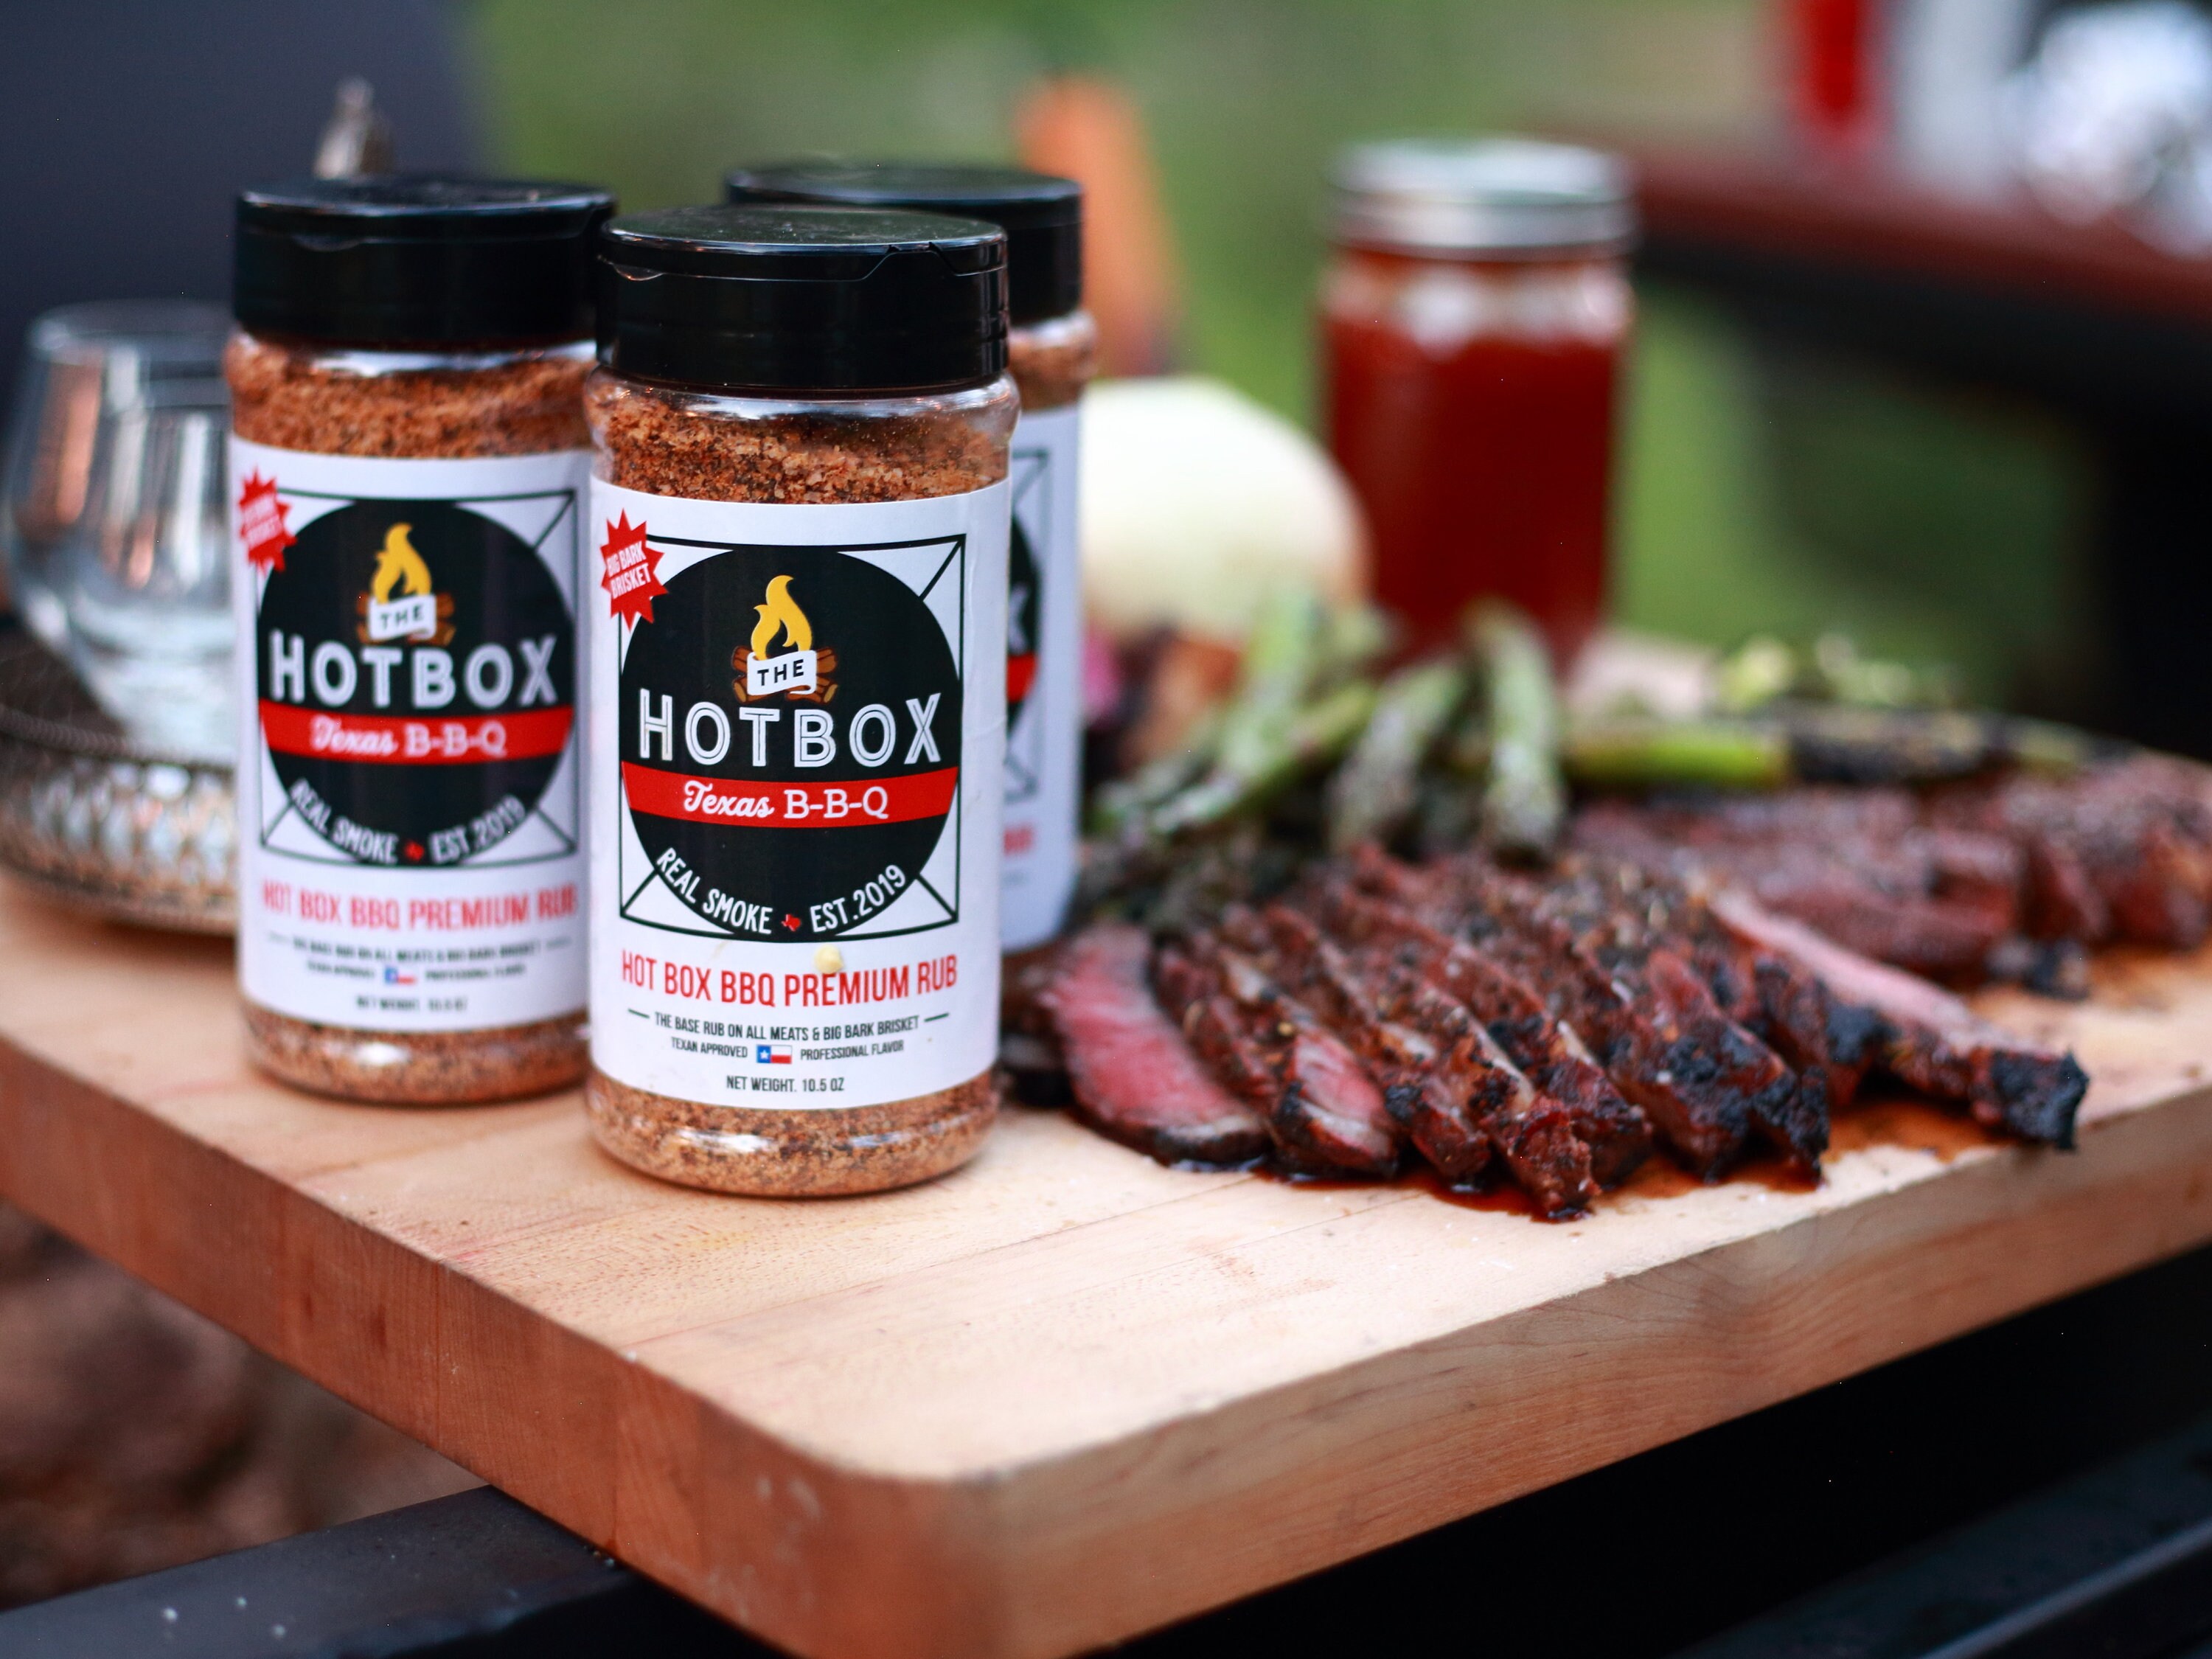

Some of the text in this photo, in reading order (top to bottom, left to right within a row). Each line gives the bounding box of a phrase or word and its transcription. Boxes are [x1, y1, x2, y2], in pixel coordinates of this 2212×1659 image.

[619, 540, 647, 571] BARK
[610, 563, 651, 599] BRISKET
[380, 605, 425, 630] THE
[268, 629, 557, 709] HOTBOX
[757, 659, 804, 686] THE
[310, 714, 507, 758] Texas B-B-Q
[639, 688, 941, 768] HOTBOX
[684, 780, 888, 819] Texas B-B-Q
[290, 777, 332, 835] REAL
[333, 815, 399, 863] SMOKE
[261, 878, 292, 914] HOT
[299, 887, 341, 922] BOX
[350, 894, 400, 931] BBQ
[408, 891, 529, 931] PREMIUM
[656, 847, 700, 903] REAL
[703, 888, 773, 934] SMOKE
[622, 949, 958, 1007] HOT BOX BBQ PREMIUM RUB
[655, 1011, 919, 1041] THE BASE RUB ON ALL MEATS & BIG BARK BRISKET
[671, 1036, 905, 1060] TEXAN APPROVED PROFESSIONAL FLAVOR
[726, 1075, 748, 1090] NET
[802, 1078, 827, 1092] 10.5
[831, 1077, 845, 1091] OZ
